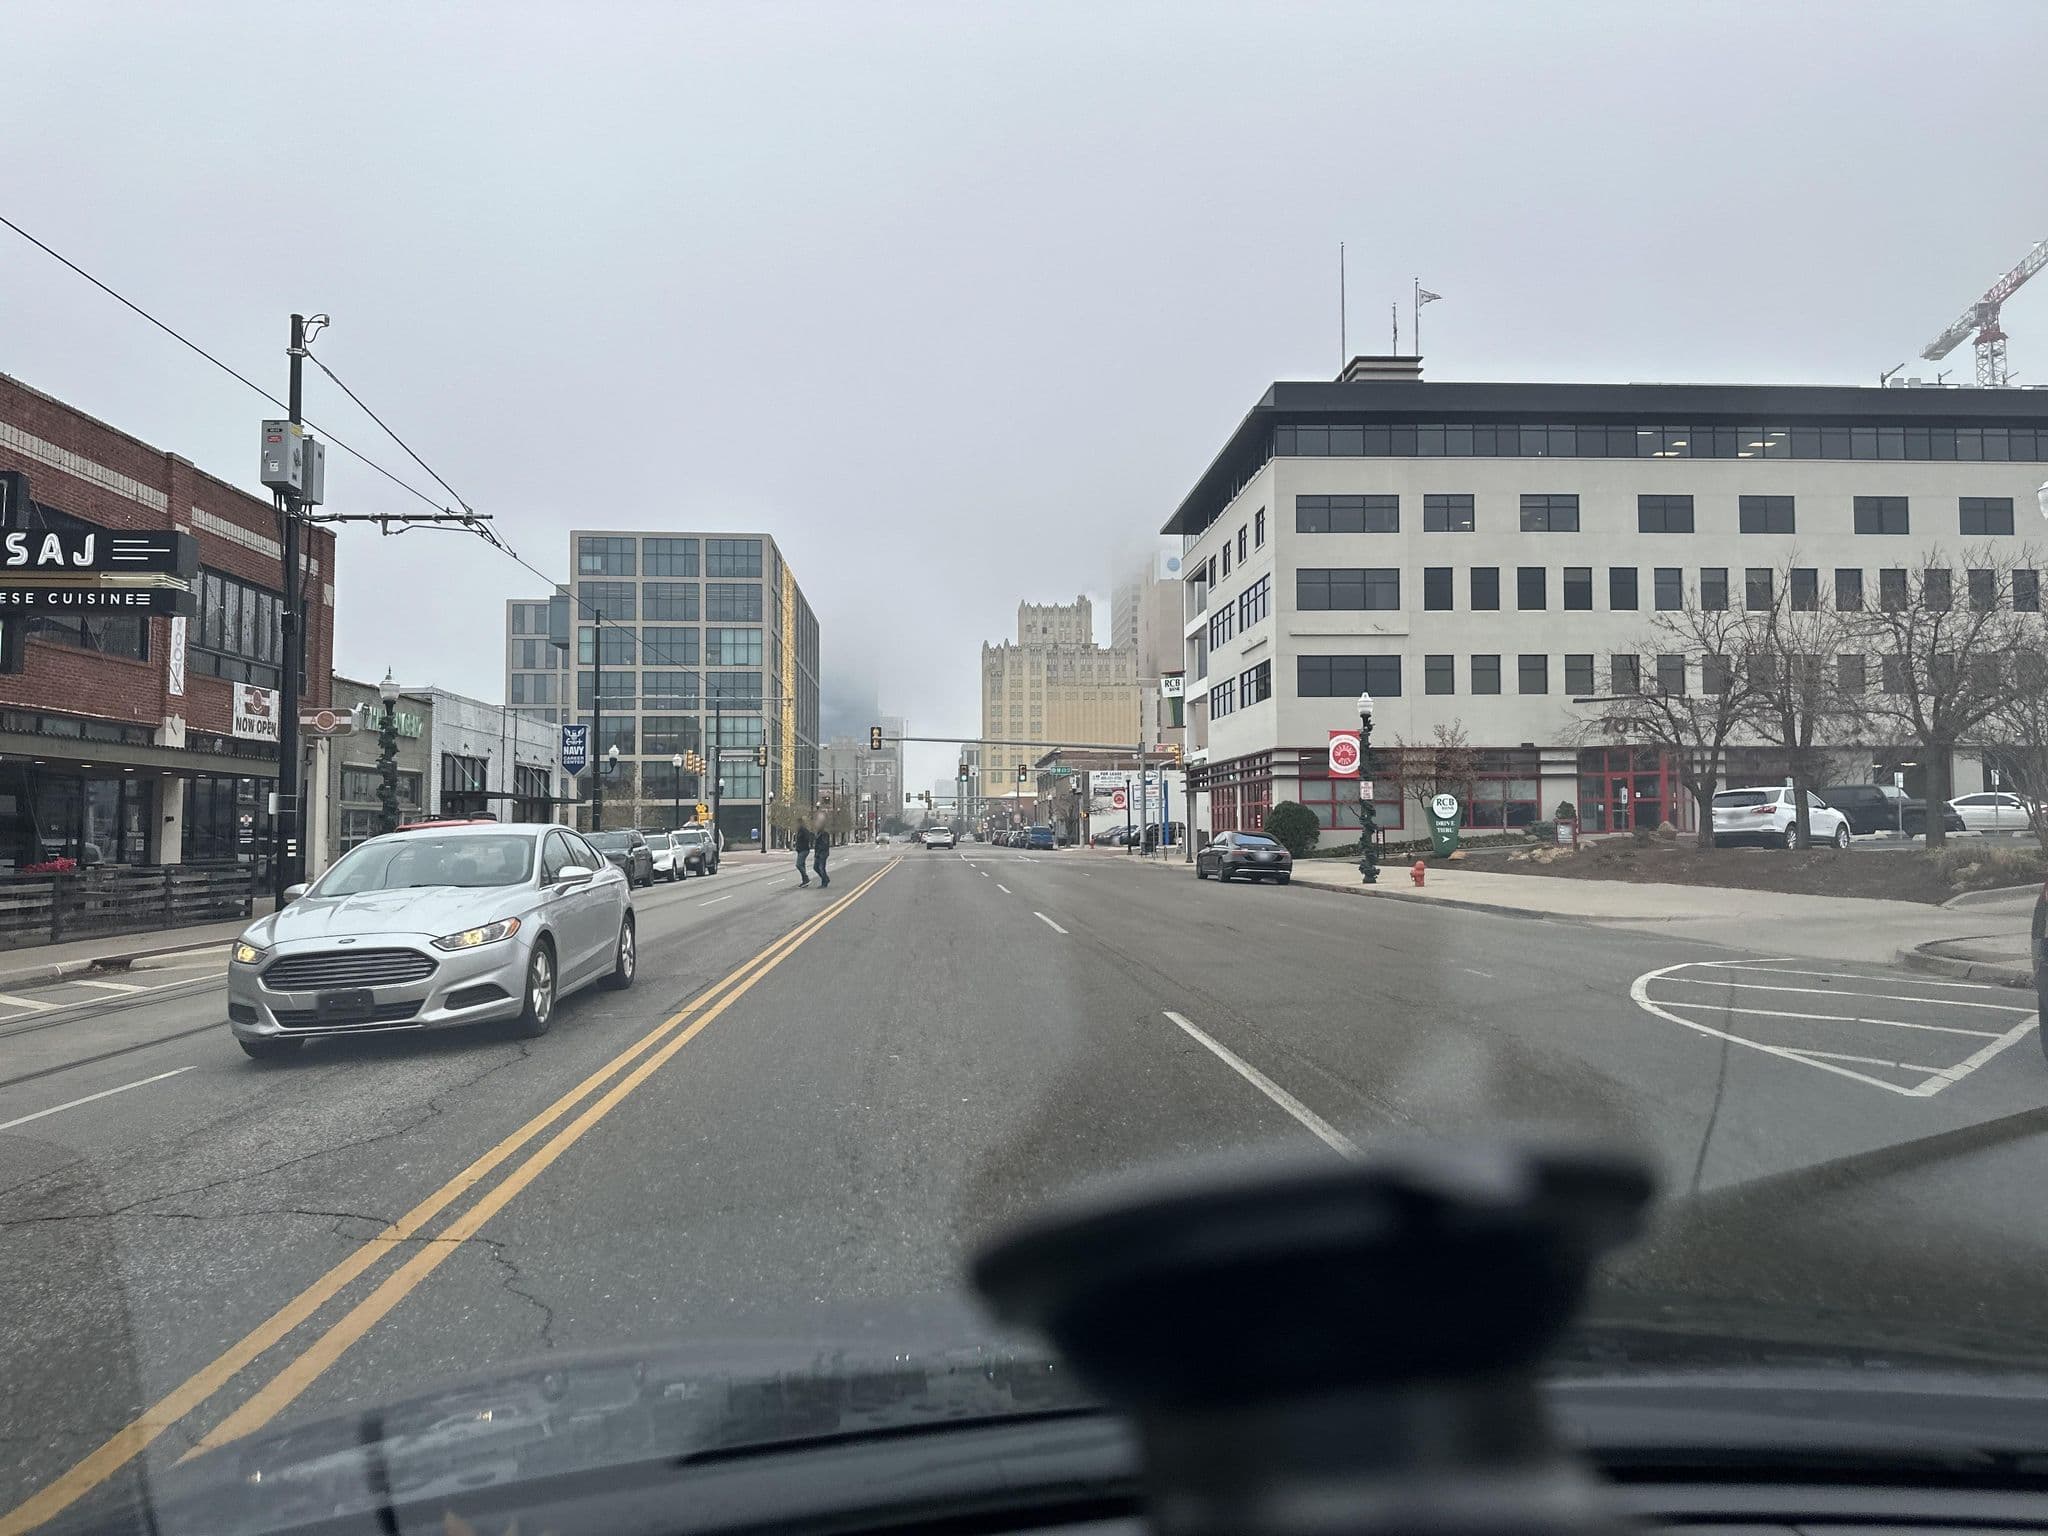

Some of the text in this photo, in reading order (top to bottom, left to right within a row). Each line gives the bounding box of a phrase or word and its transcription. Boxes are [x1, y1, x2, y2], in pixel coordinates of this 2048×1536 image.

[5, 532, 96, 567] SAJ
[48, 592, 135, 605] CUISINE
[1164, 679, 1181, 688] RCB
[235, 717, 278, 736] NOW OPEN
[563, 746, 585, 755] NAVY
[1436, 798, 1455, 807] RCB
